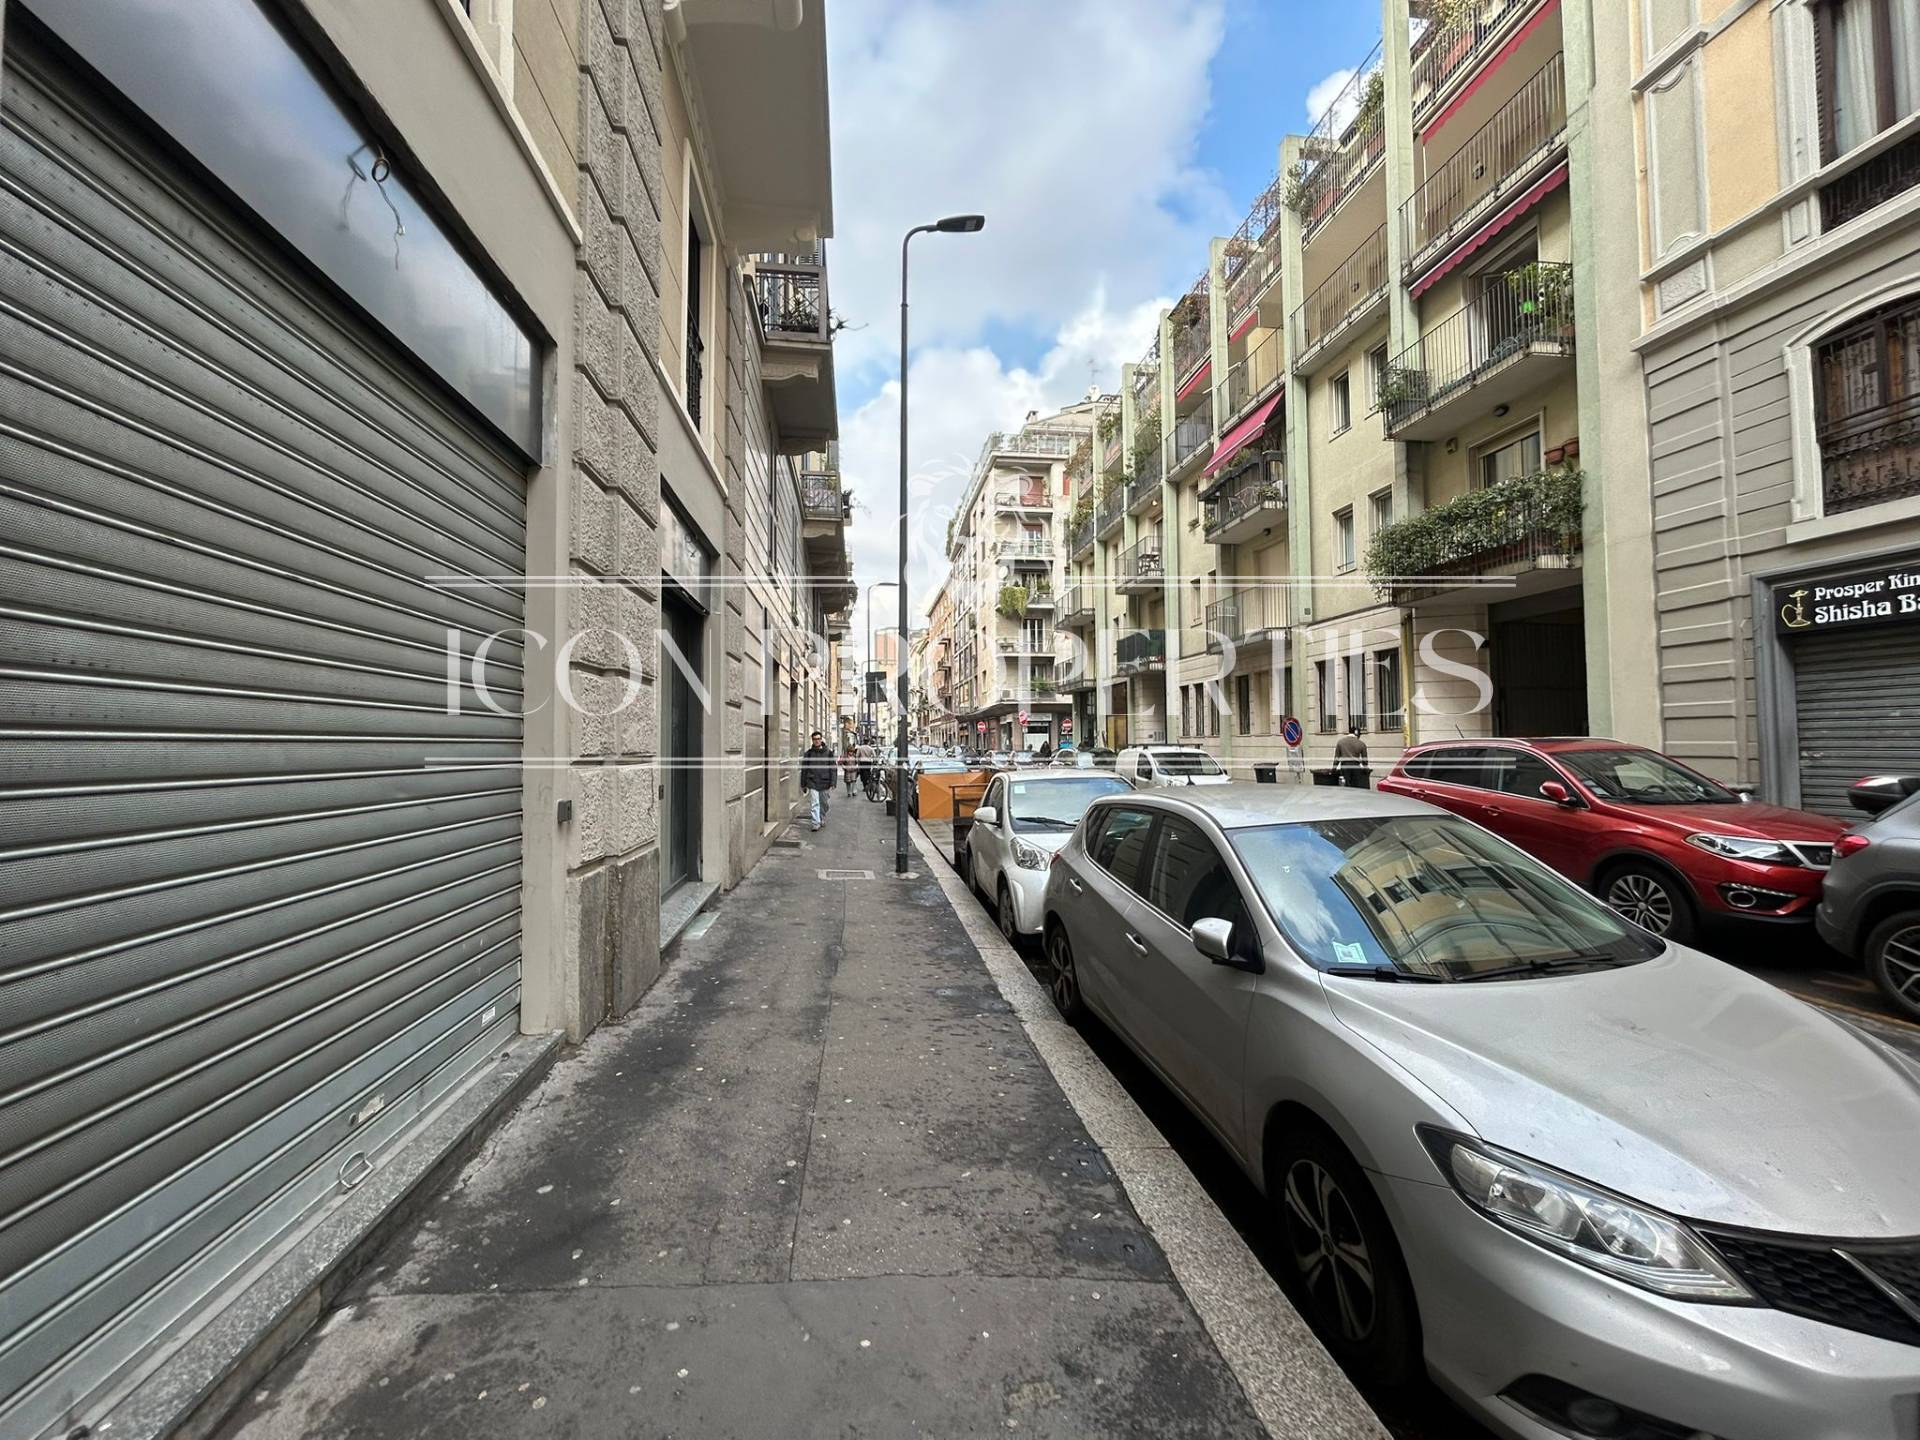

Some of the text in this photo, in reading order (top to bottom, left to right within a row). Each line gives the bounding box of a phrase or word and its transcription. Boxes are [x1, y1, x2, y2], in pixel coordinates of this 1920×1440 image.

[1814, 580, 1885, 601] Prosper
[1814, 593, 1920, 624] Shisha B
